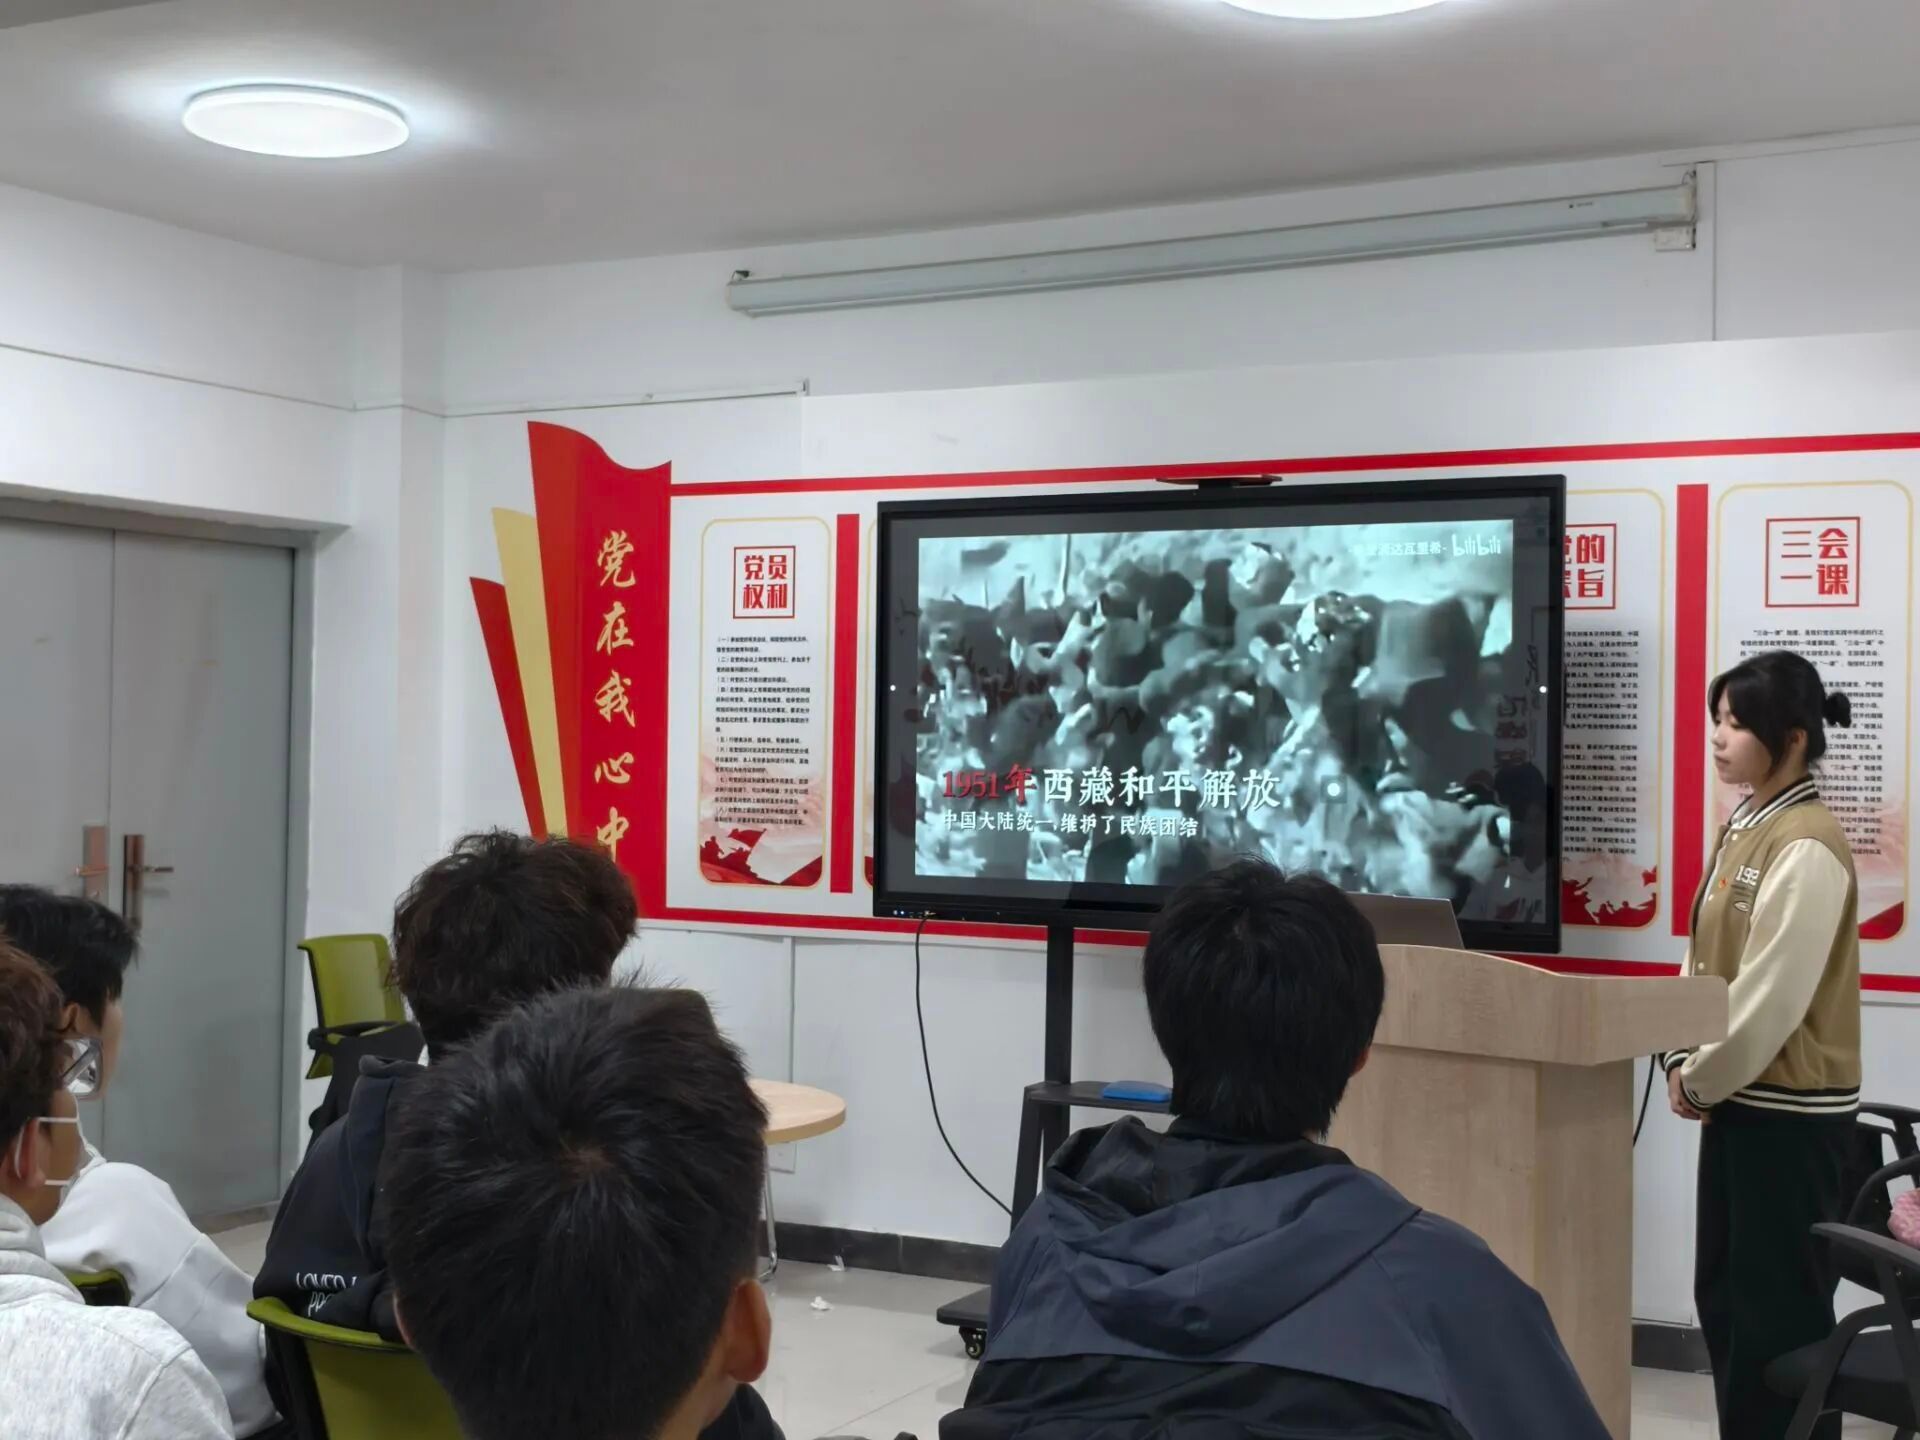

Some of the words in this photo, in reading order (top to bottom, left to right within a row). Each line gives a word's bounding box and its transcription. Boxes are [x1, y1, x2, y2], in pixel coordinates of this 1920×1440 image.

[1452, 533, 1502, 557] bilibili
[1563, 534, 1605, 565] 的
[1781, 527, 1849, 559] 三会
[744, 554, 788, 580] 党员
[1780, 563, 1850, 595] 一课
[743, 583, 788, 609] 权利
[1563, 568, 1605, 598] 旨
[594, 530, 636, 861] 党在我心中
